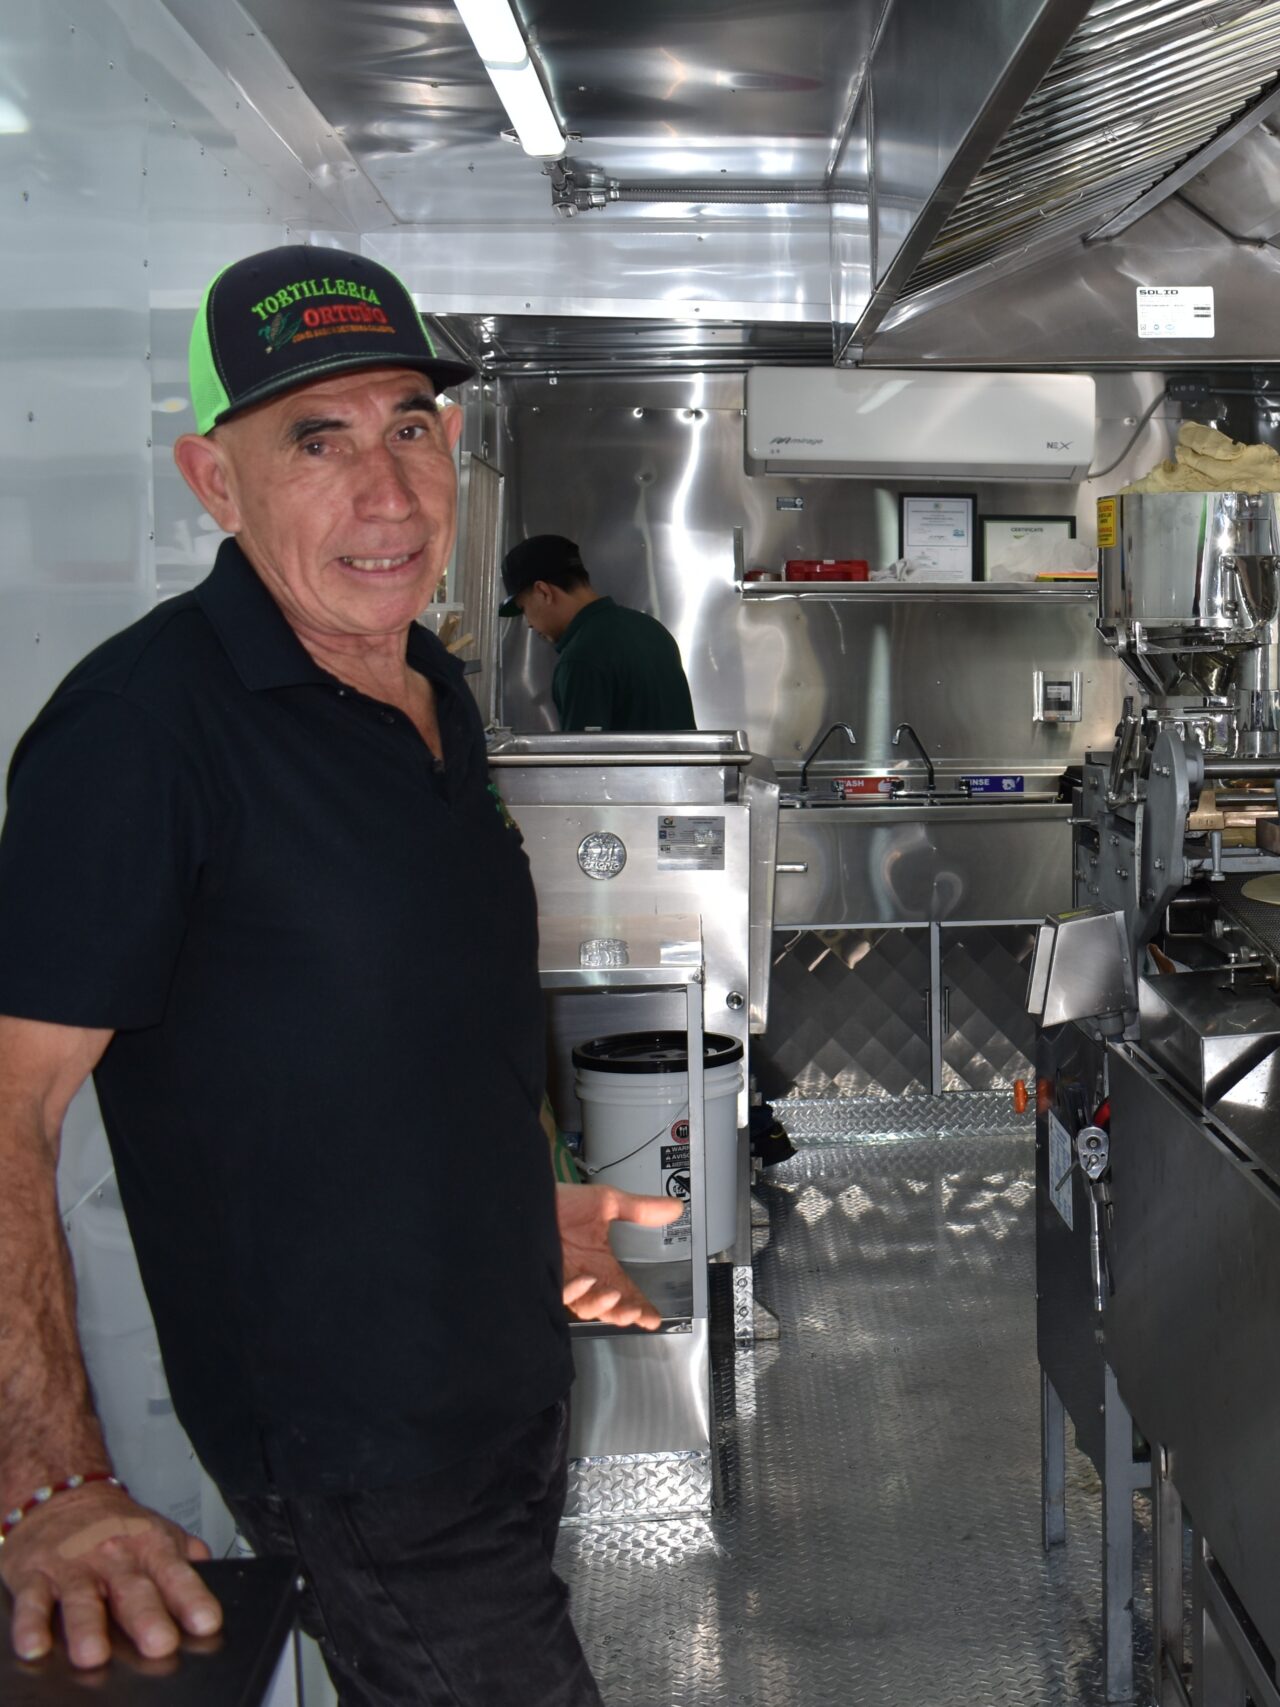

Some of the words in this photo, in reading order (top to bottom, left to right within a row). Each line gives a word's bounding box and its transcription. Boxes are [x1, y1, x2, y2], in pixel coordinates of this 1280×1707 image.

[251, 277, 382, 321] TORTILLERIA
[303, 301, 389, 328] ORTUÑO
[969, 778, 990, 786] INSE
